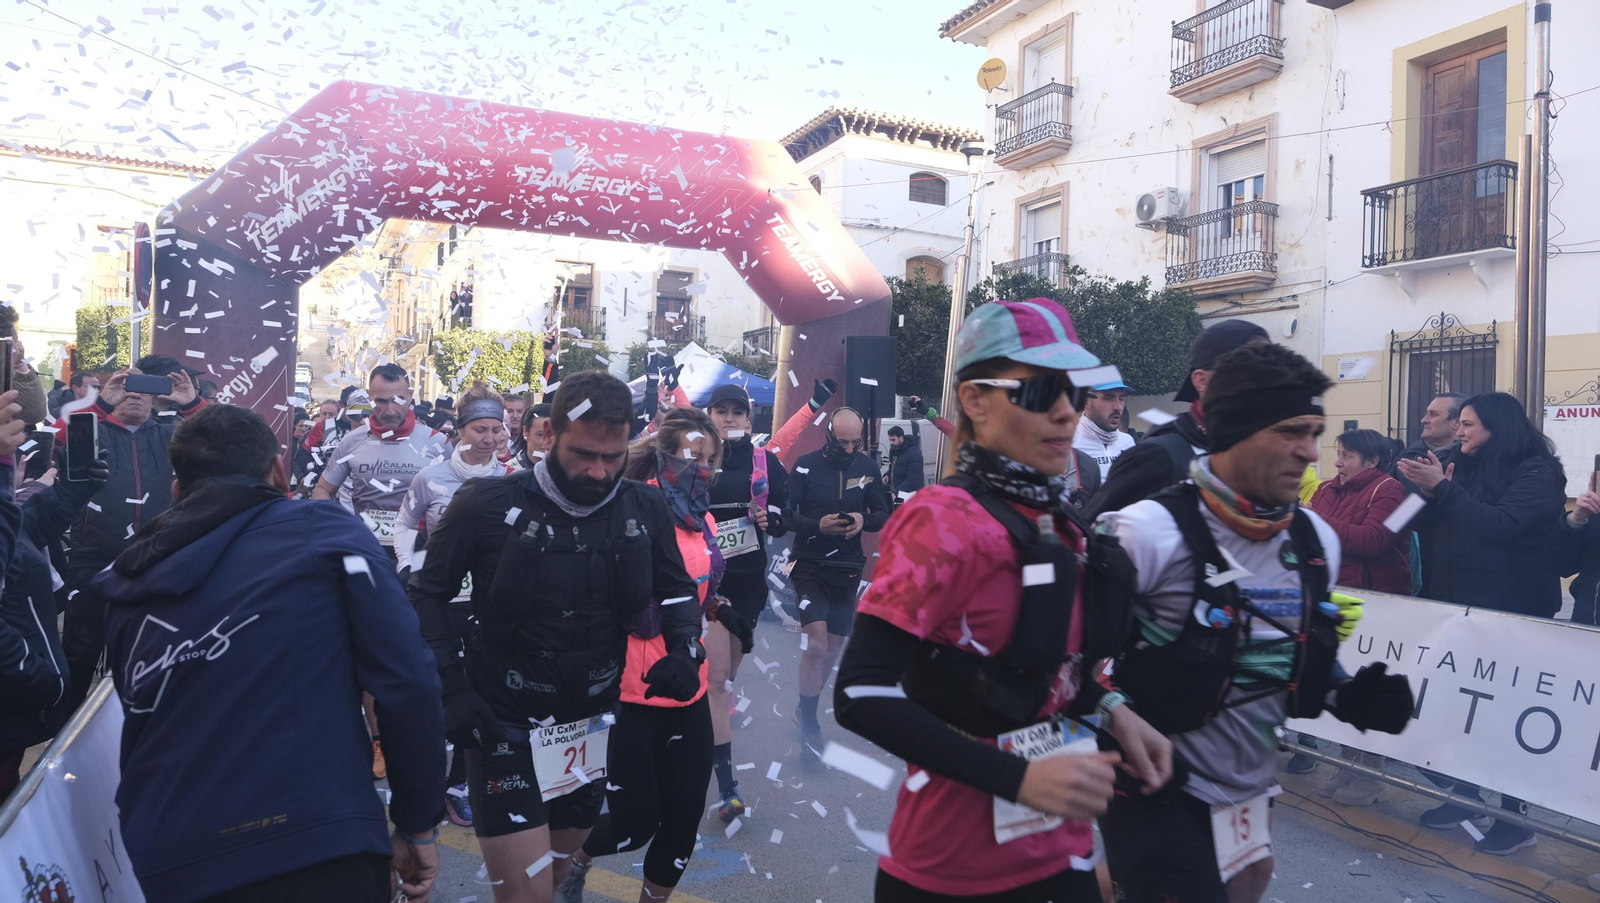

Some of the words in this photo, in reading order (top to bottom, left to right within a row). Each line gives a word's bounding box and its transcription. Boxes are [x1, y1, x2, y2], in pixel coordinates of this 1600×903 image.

[514, 166, 641, 196] TEAMERGY
[247, 153, 368, 251] TEAMERGY
[766, 212, 845, 301] TEAMERGY
[717, 530, 746, 549] 297
[179, 649, 207, 662] STOP
[542, 739, 552, 747] LA
[544, 727, 555, 737] IV
[557, 723, 577, 735] CxM
[564, 740, 586, 775] 21
[1230, 806, 1251, 846] 15
